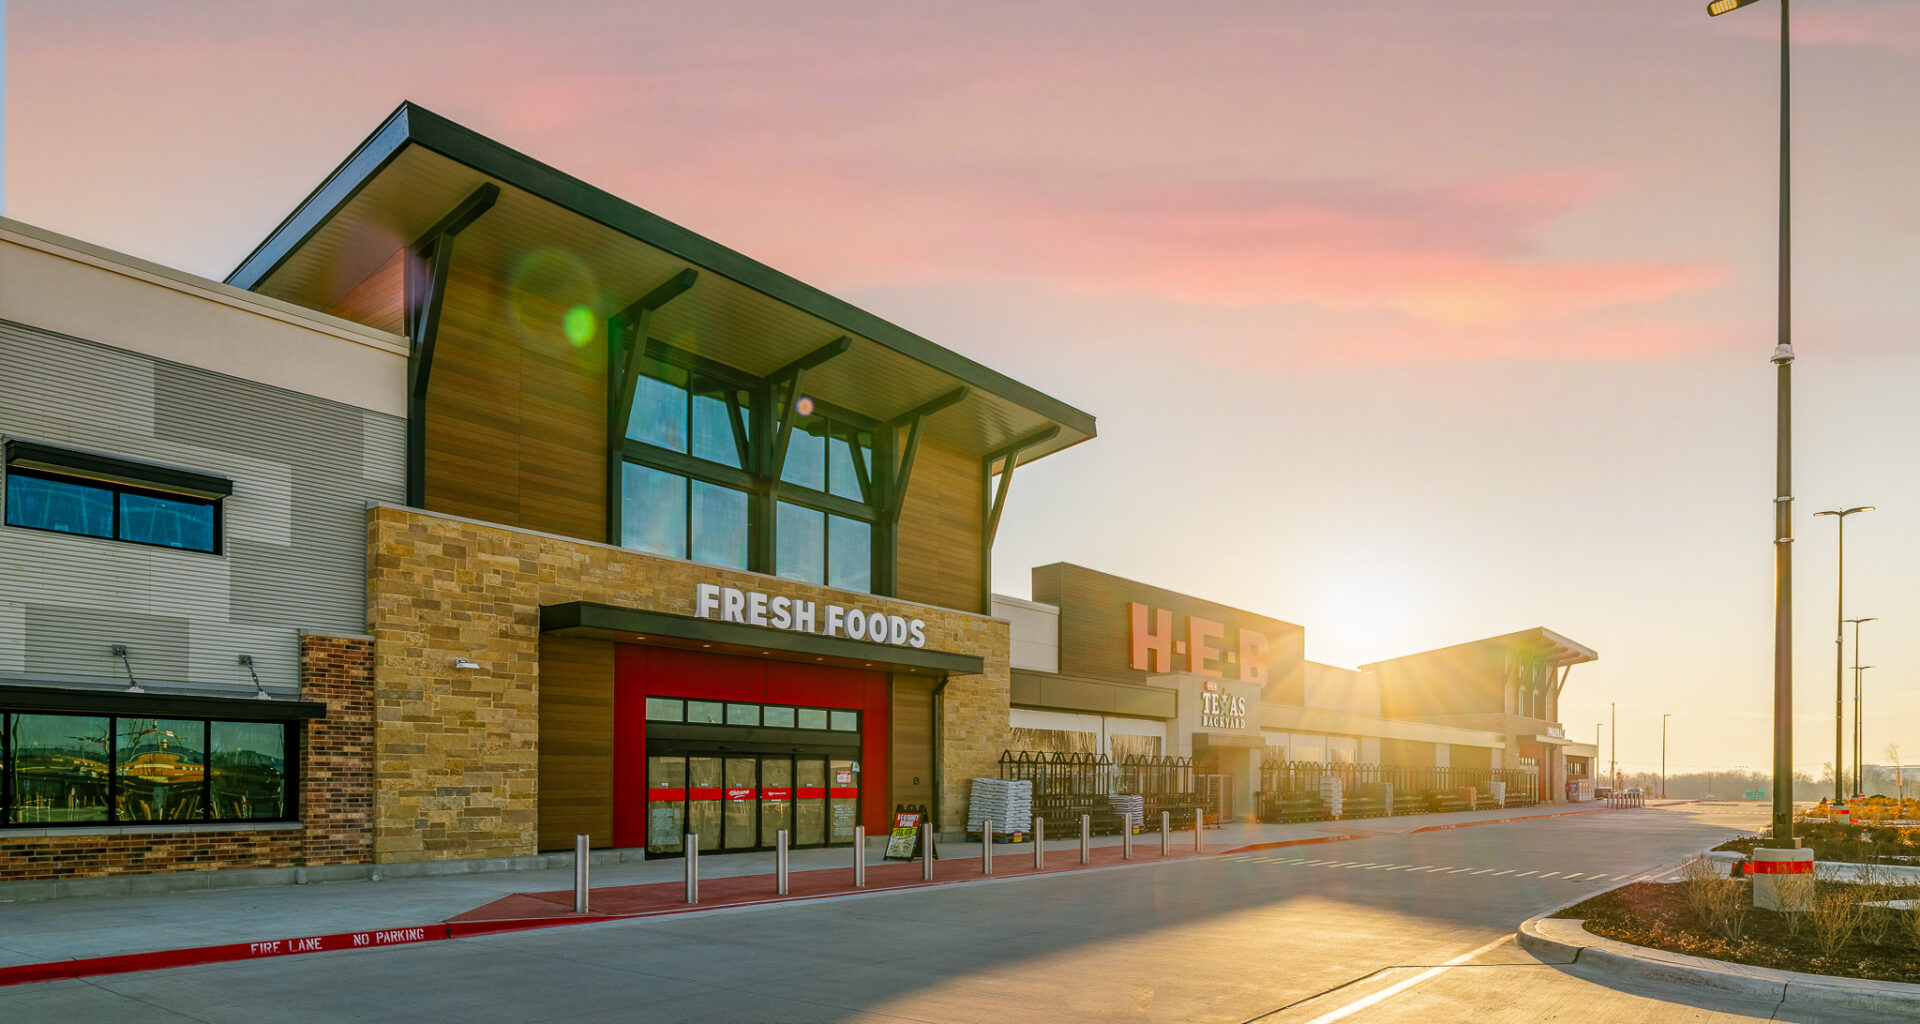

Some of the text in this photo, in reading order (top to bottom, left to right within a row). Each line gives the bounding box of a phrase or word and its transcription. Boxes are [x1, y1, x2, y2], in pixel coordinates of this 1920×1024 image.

[695, 583, 926, 648] FRESH FOODS
[1201, 692, 1246, 717] TEXAS
[1202, 715, 1246, 729] BACKYARD
[250, 937, 323, 955] FIRE LANE
[353, 928, 424, 946] NO PARKING
